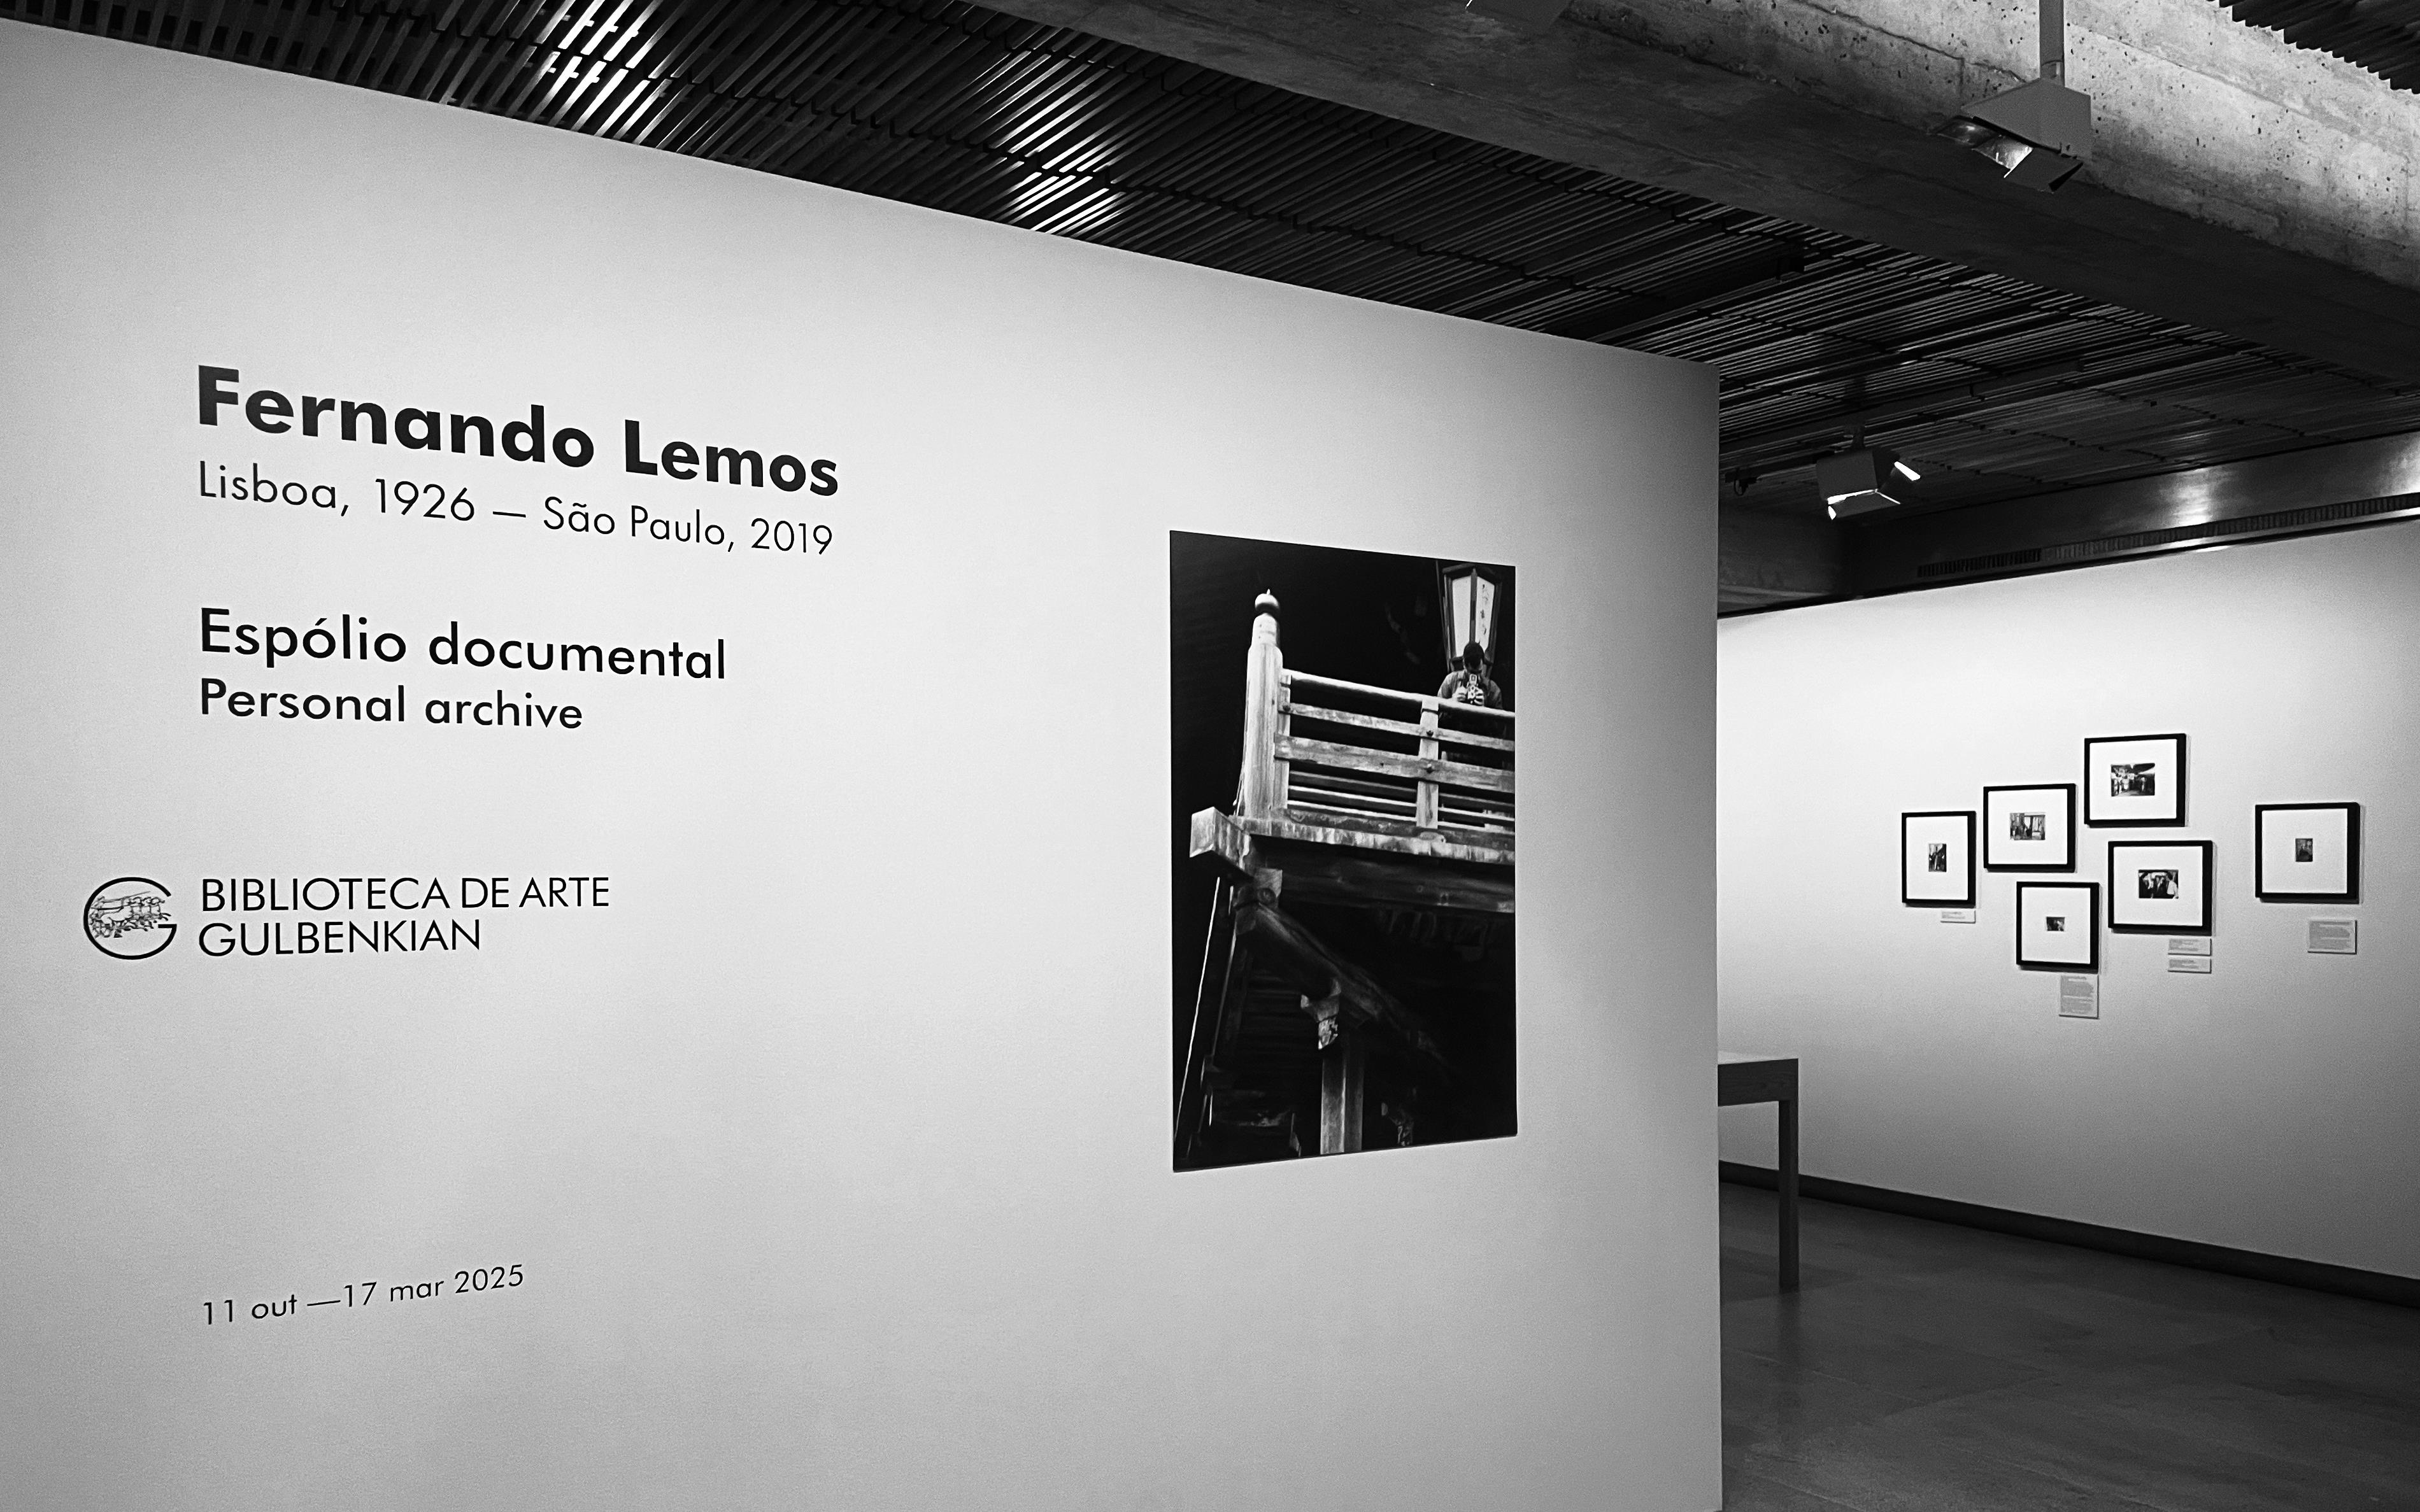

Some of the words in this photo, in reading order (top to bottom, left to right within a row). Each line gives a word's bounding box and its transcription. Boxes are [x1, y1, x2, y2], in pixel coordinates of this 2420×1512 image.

[198, 365, 594, 468] Fernando
[625, 419, 838, 497] Lemos
[199, 460, 349, 517] Lisboa,
[375, 478, 475, 521] 1926
[543, 496, 615, 535] São
[631, 505, 734, 553] Paulo,
[751, 518, 832, 555] 2019
[201, 607, 406, 668] Espólio
[429, 621, 725, 679] documental
[201, 677, 404, 722] Personal
[425, 689, 583, 729] archive
[203, 877, 451, 912] BIBLIOTECA
[462, 877, 510, 908] DE
[518, 877, 609, 907] ARTE
[199, 919, 480, 957] GULBENKIAN
[203, 1299, 233, 1325] 11
[251, 1294, 297, 1319] out
[390, 1280, 445, 1302] mar
[454, 1264, 523, 1294] 2025
